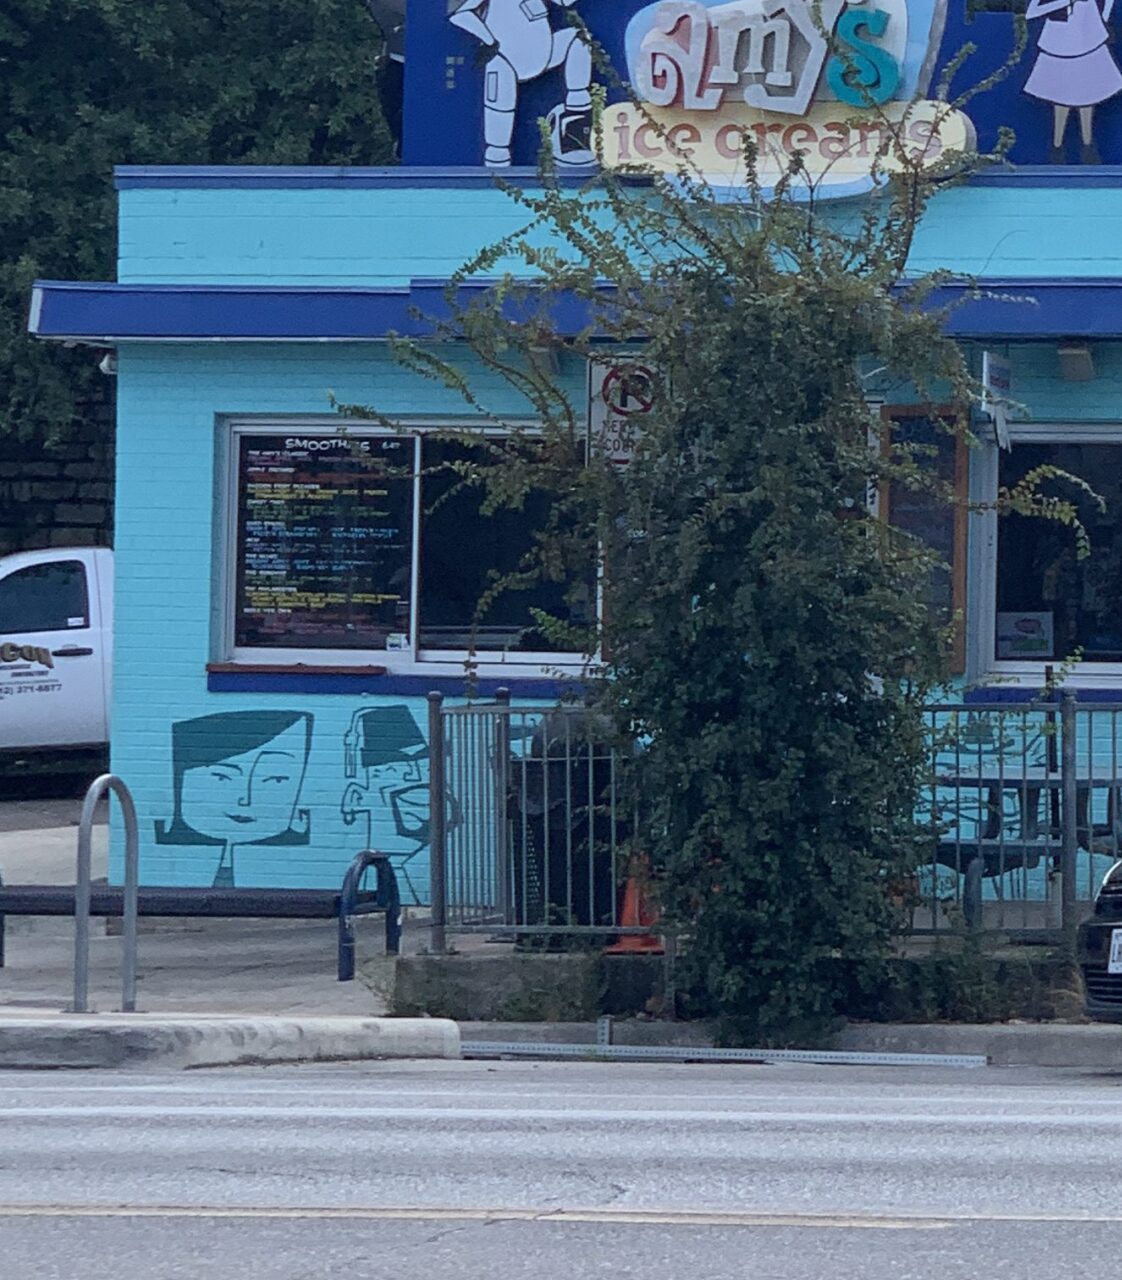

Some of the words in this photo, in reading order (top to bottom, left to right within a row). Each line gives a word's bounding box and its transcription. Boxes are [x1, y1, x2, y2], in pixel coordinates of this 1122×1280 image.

[613, 111, 701, 160] ice
[715, 120, 943, 160] creams
[285, 438, 370, 451] SMOOTHS
